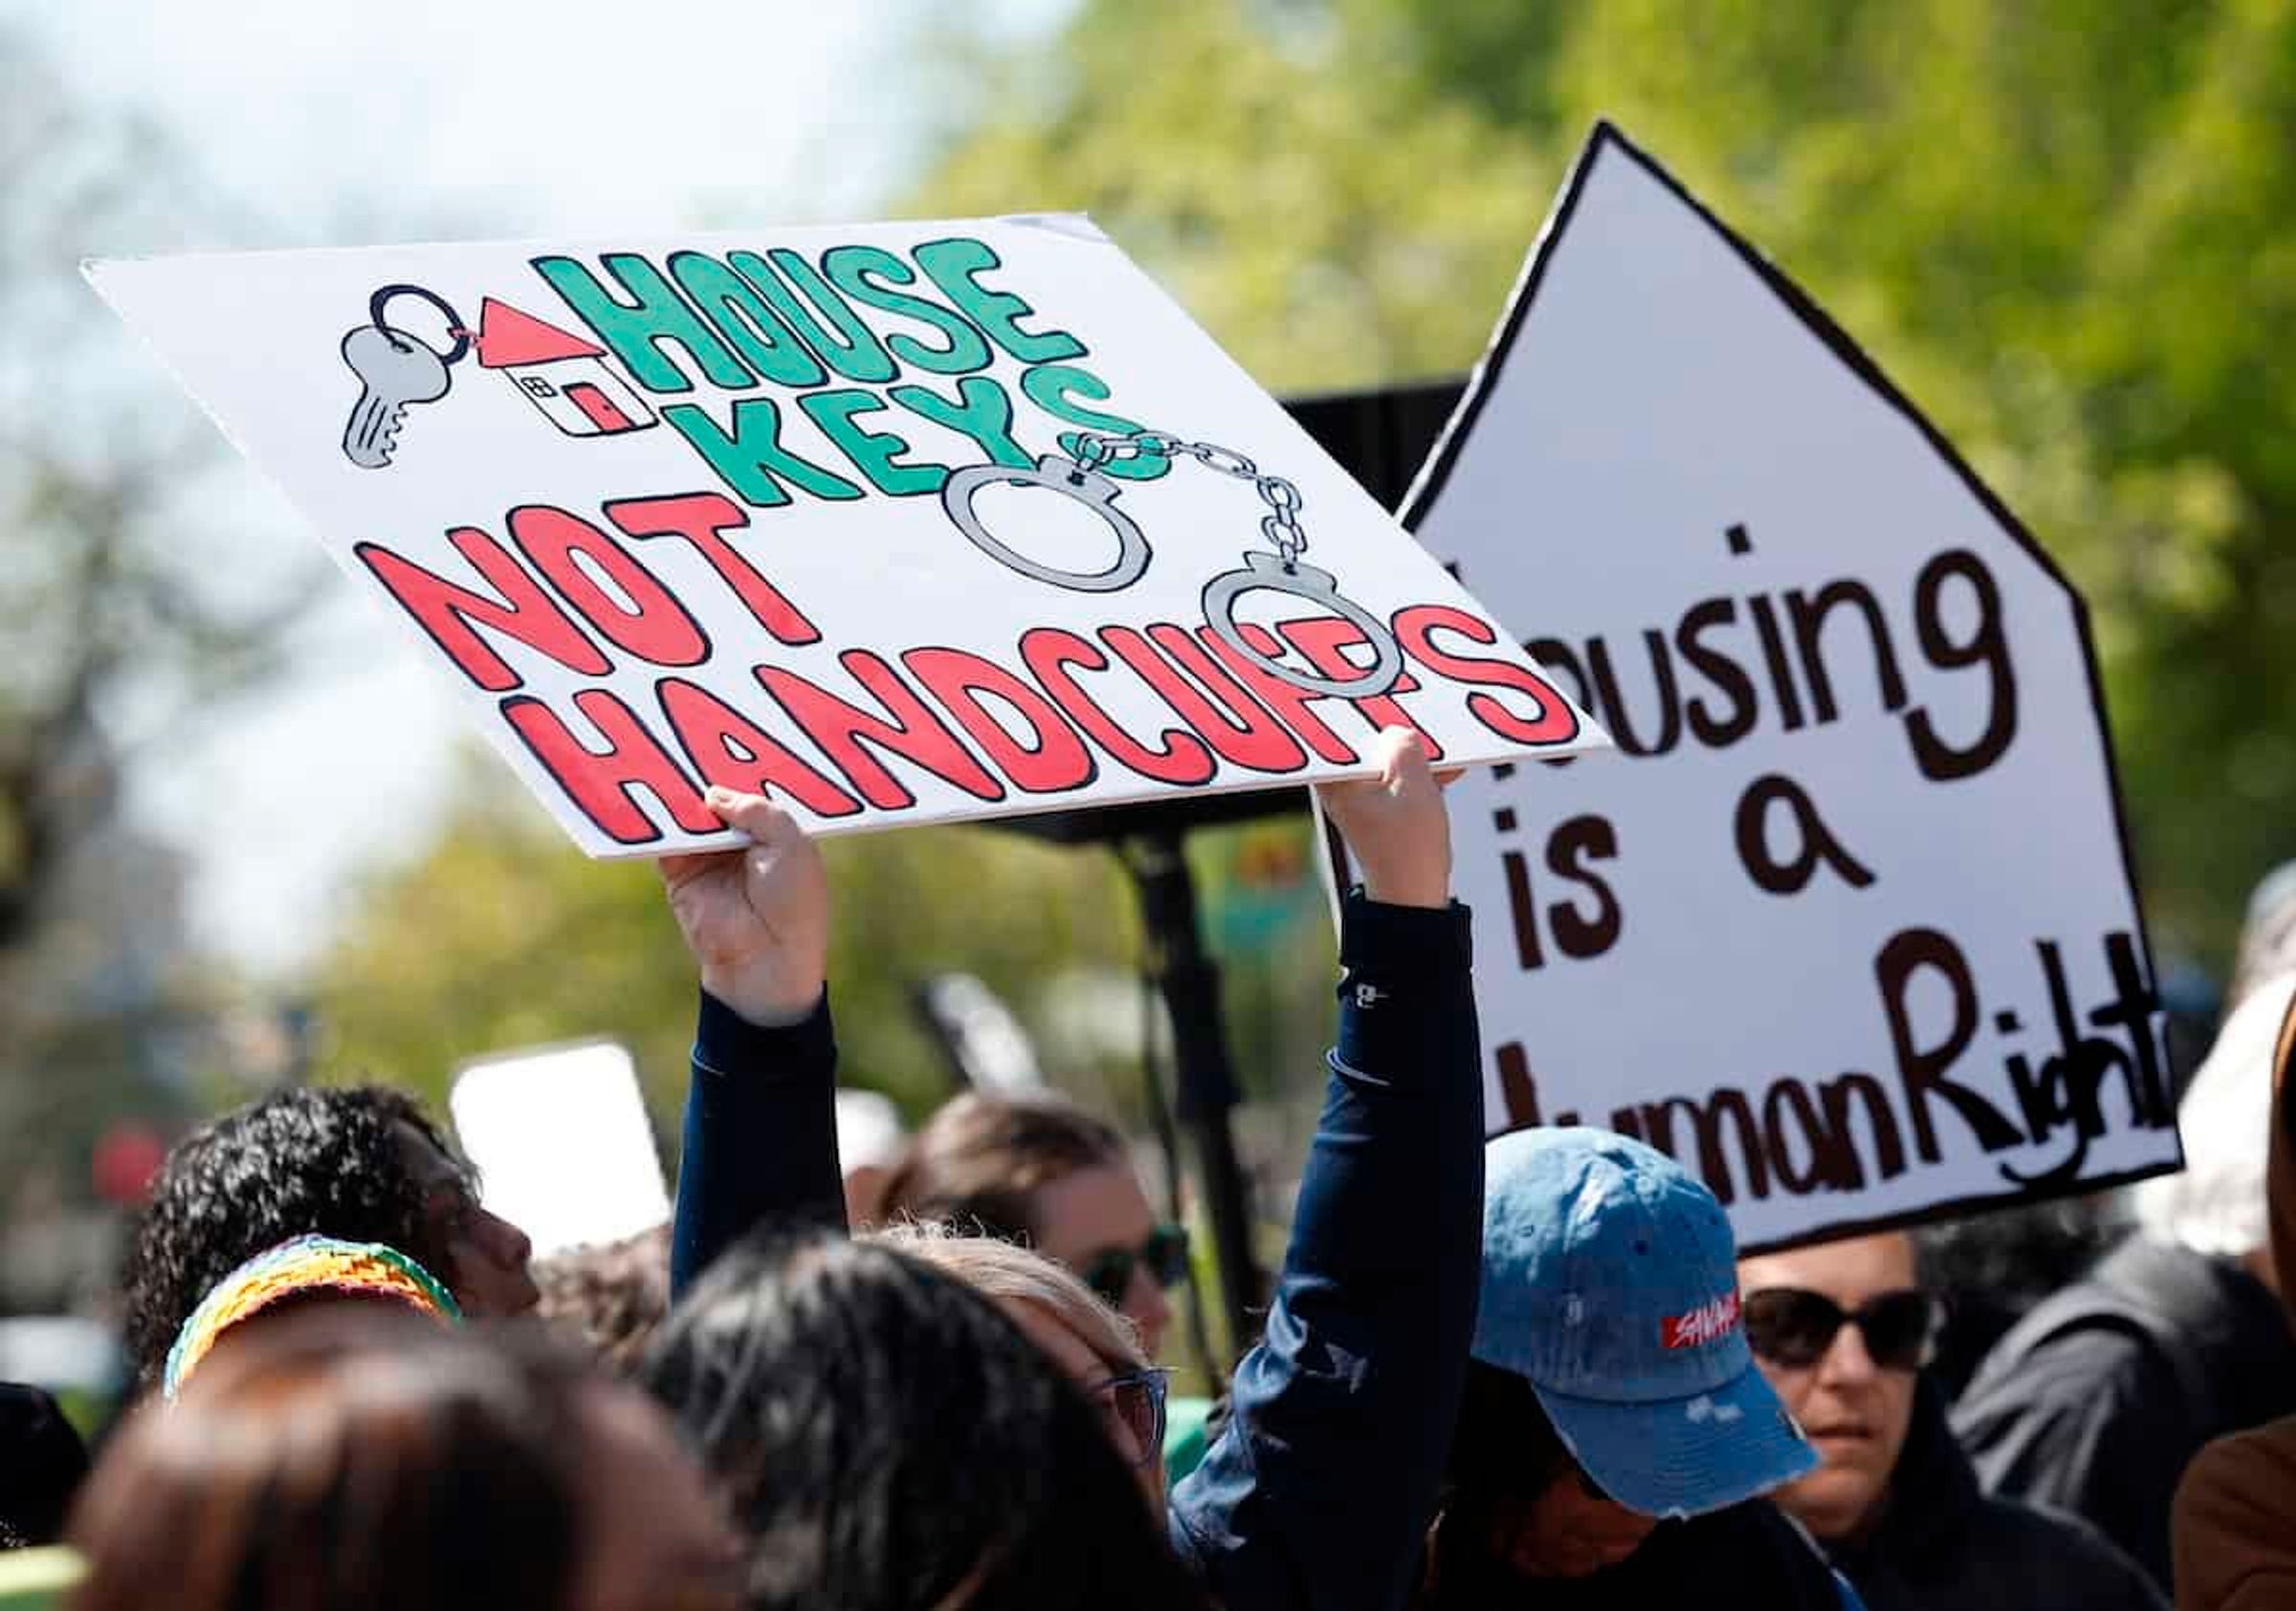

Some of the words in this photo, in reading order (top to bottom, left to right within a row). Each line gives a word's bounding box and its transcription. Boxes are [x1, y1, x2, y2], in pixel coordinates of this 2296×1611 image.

[530, 238, 1089, 393] HOUSE
[660, 365, 1172, 507] KEYS
[355, 492, 822, 691] NOT
[1445, 523, 2016, 782] using
[500, 605, 1578, 845] HANDCUFFS
[1494, 807, 1623, 971] is
[1733, 773, 1877, 895] a
[1494, 1040, 1907, 1205] man
